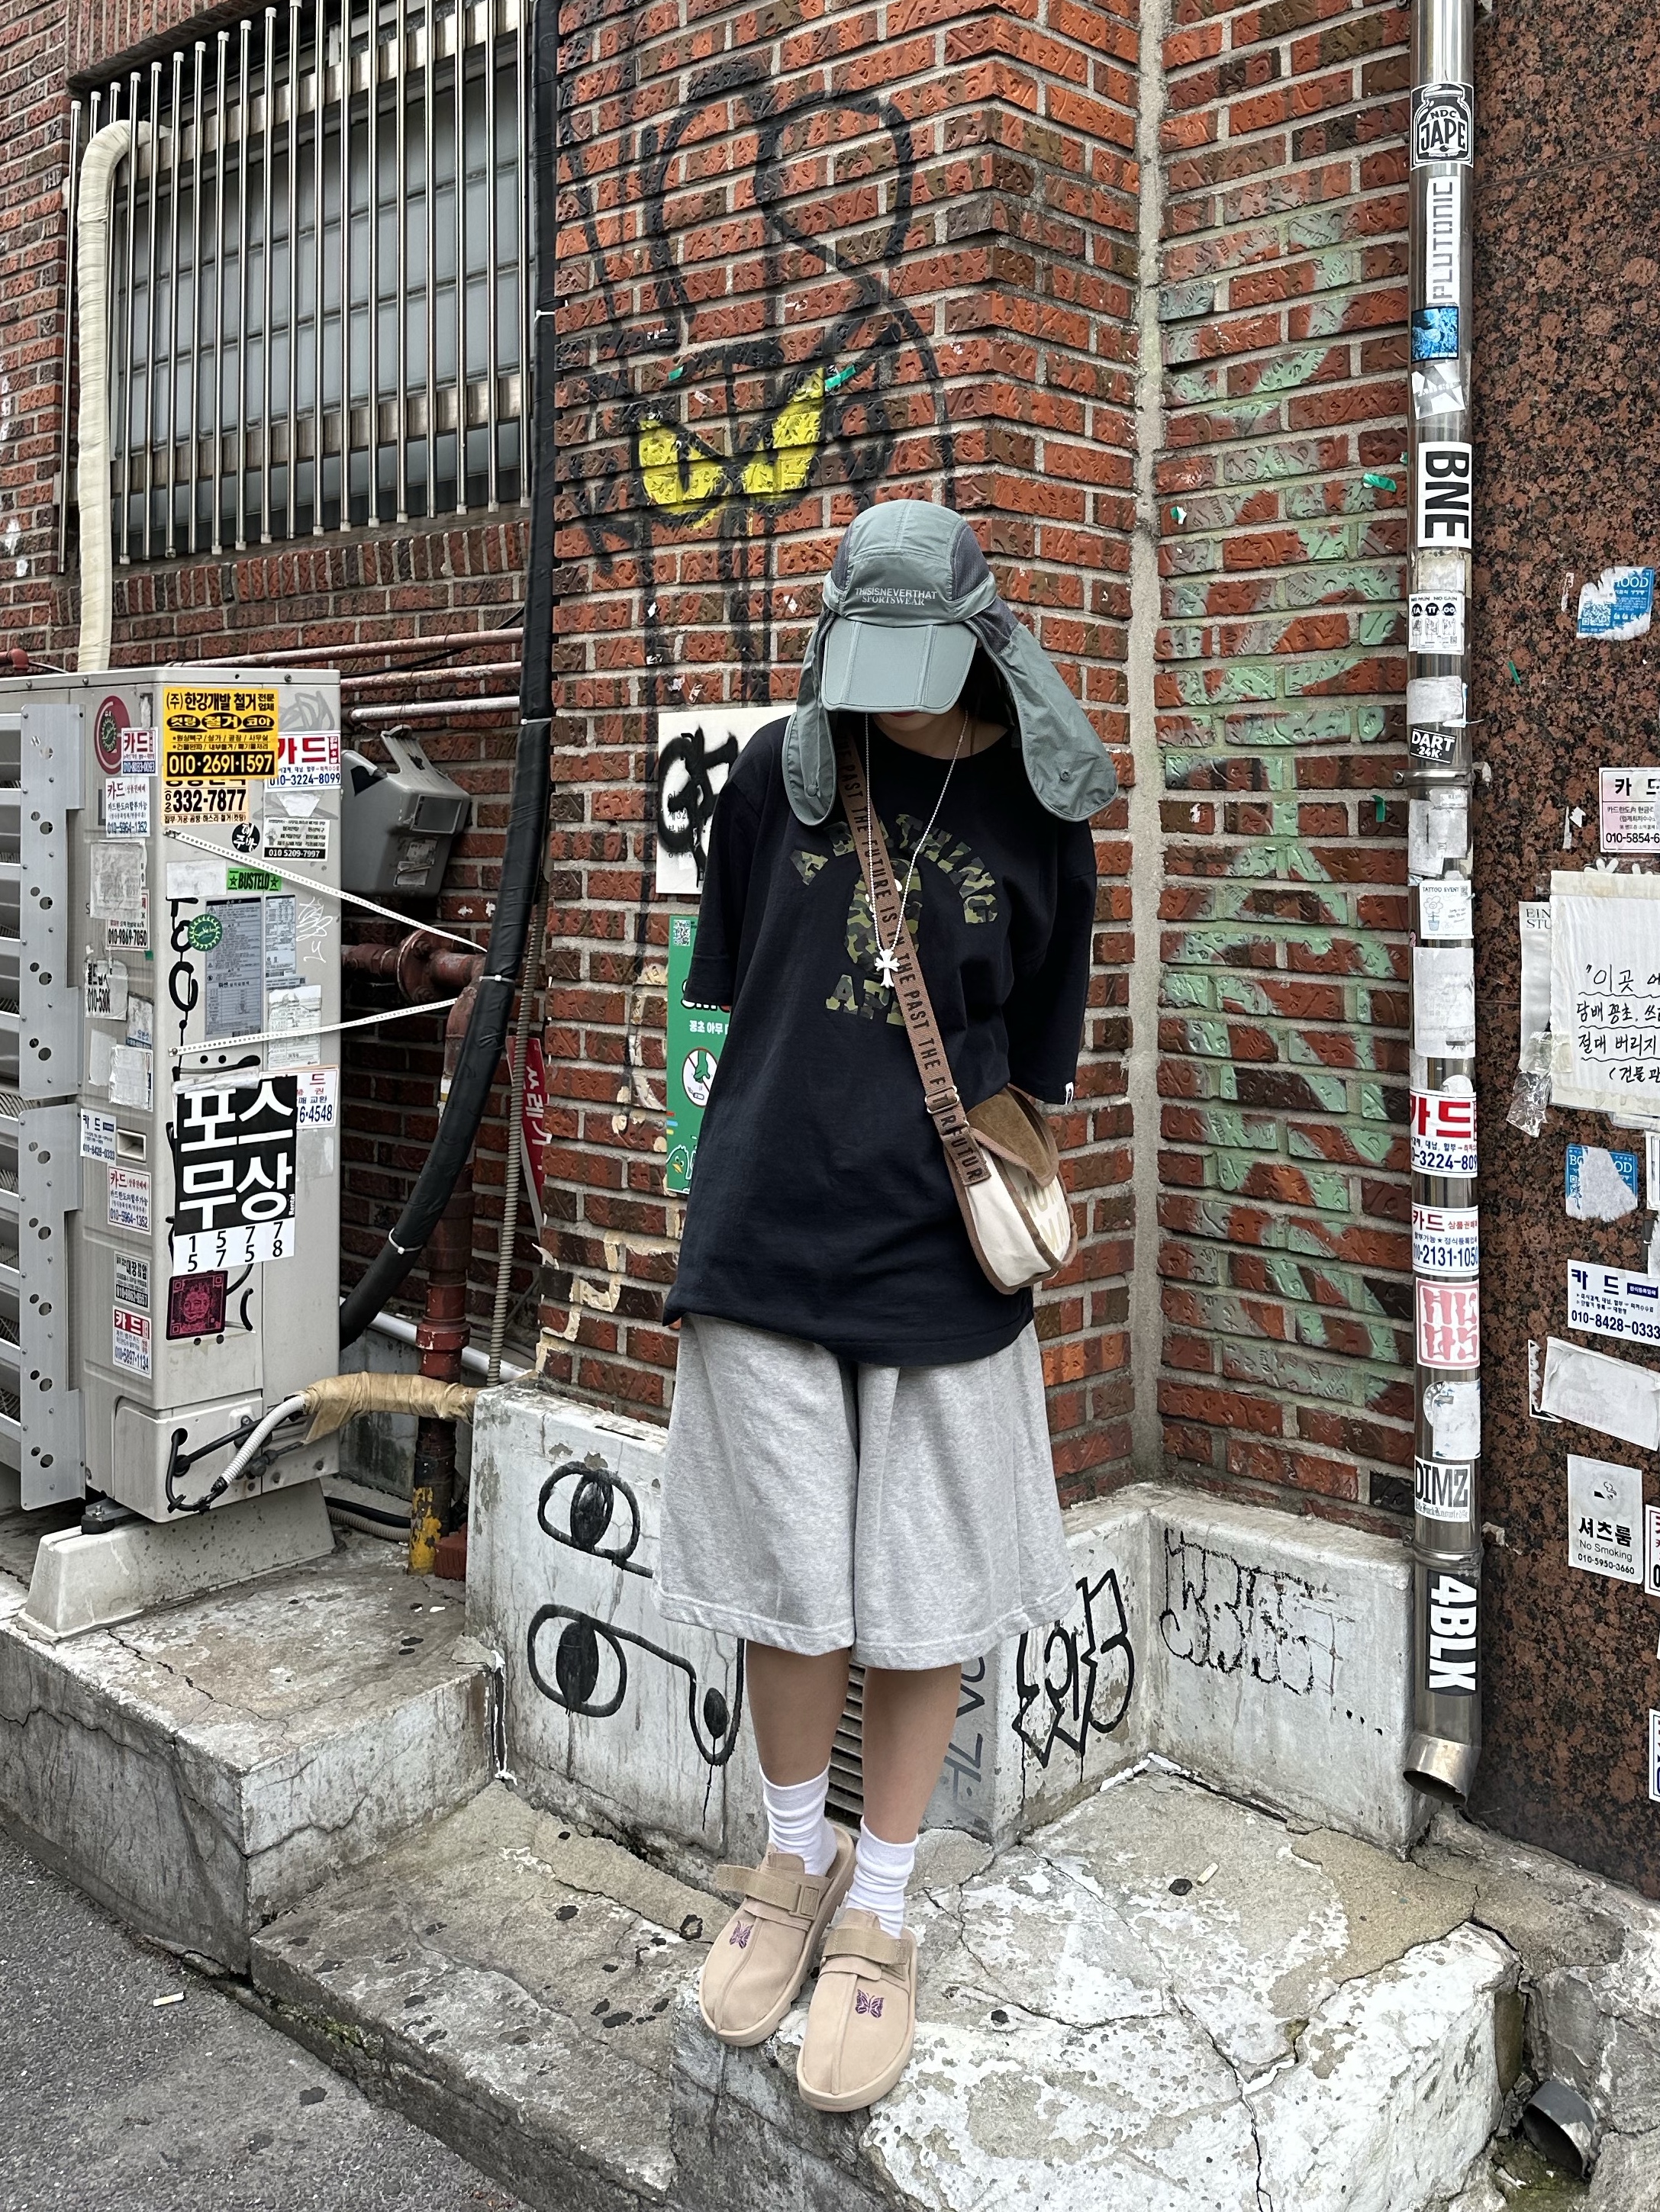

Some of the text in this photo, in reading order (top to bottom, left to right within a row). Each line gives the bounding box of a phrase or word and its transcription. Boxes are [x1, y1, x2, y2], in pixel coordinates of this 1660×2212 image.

[1430, 109, 1457, 120] NDC
[1420, 118, 1466, 152] JAPE
[1433, 182, 1453, 299] PLUTONIC
[1425, 451, 1469, 539] BNE
[855, 587, 938, 600] THISISNEVERTHAT
[862, 595, 925, 606] SPORTSWEAR
[166, 692, 256, 711] (주) 한강개발 철거
[257, 694, 276, 702] 전문
[204, 716, 239, 729] 철거
[246, 717, 272, 726] 코아
[124, 732, 148, 753] 카드
[1411, 730, 1455, 753] DART
[108, 781, 125, 800] 카드
[270, 772, 341, 785] 010-3224-8099
[840, 765, 864, 799] PAST
[172, 789, 247, 813] 332-7877
[851, 805, 874, 834] THE
[824, 813, 999, 925] BTHING
[861, 838, 892, 900] FUTURE
[904, 989, 930, 1030] PAST
[1576, 1000, 1604, 1022] 담배
[1644, 1004, 1660, 1022] 쓰
[706, 1021, 724, 1035] 아무
[917, 1037, 941, 1071] THE
[1578, 1031, 1656, 1057] 절대 버리지
[82, 1114, 101, 1132] 카드
[180, 1079, 293, 1153] 포스
[110, 1170, 127, 1190] 카드
[179, 1152, 292, 1230] 무상
[1413, 1210, 1445, 1232] 카드
[1571, 1268, 1620, 1295] 카드
[116, 1311, 141, 1335] 카드
[1571, 1309, 1660, 1340] 010-8428-0333
[1415, 1460, 1468, 1508] DIMZ
[1578, 1517, 1632, 1547] 셔츠룸
[1579, 1539, 1633, 1563] No Smoking
[1578, 1553, 1635, 1575] 010-5950-3660
[1428, 1575, 1478, 1691] 4BLK
